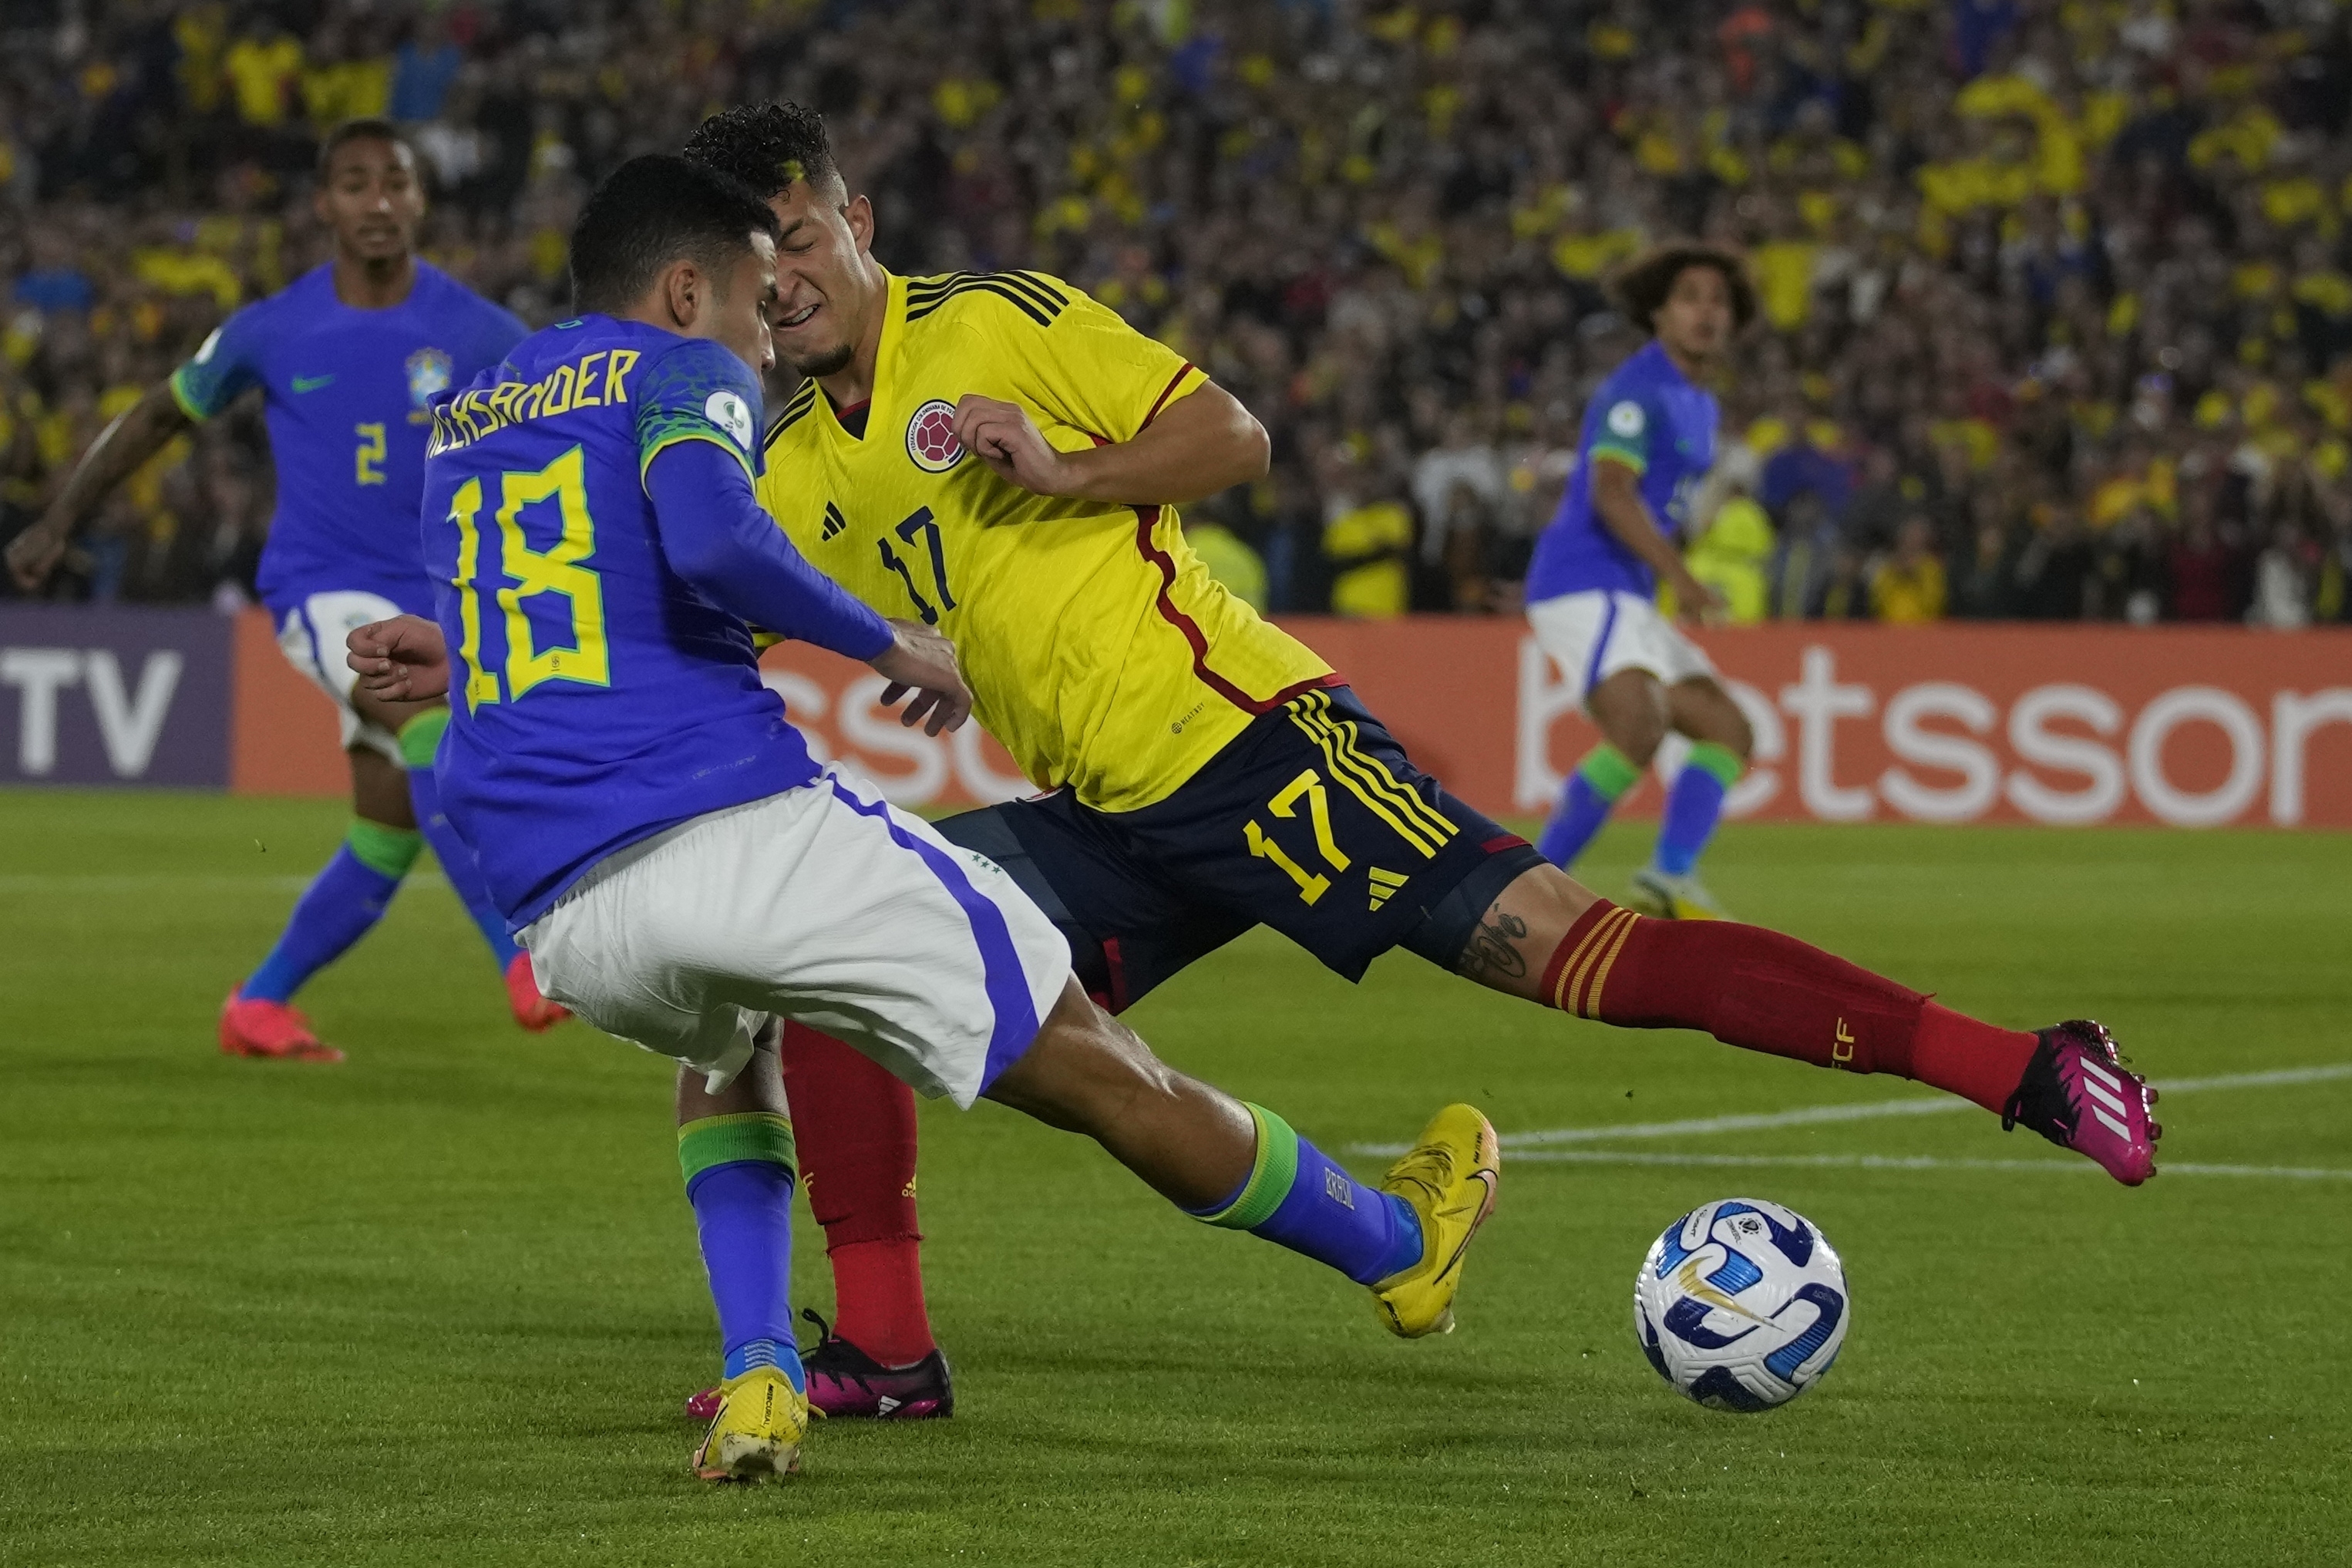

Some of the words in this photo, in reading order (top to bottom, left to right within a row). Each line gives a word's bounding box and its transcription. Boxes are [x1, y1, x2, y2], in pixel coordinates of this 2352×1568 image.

[355, 422, 386, 486] 2
[446, 443, 611, 720] 18
[878, 505, 958, 625] 17
[0, 648, 183, 777] TV
[1242, 768, 1351, 907] 17
[1324, 1166, 1355, 1210] BRASIL
